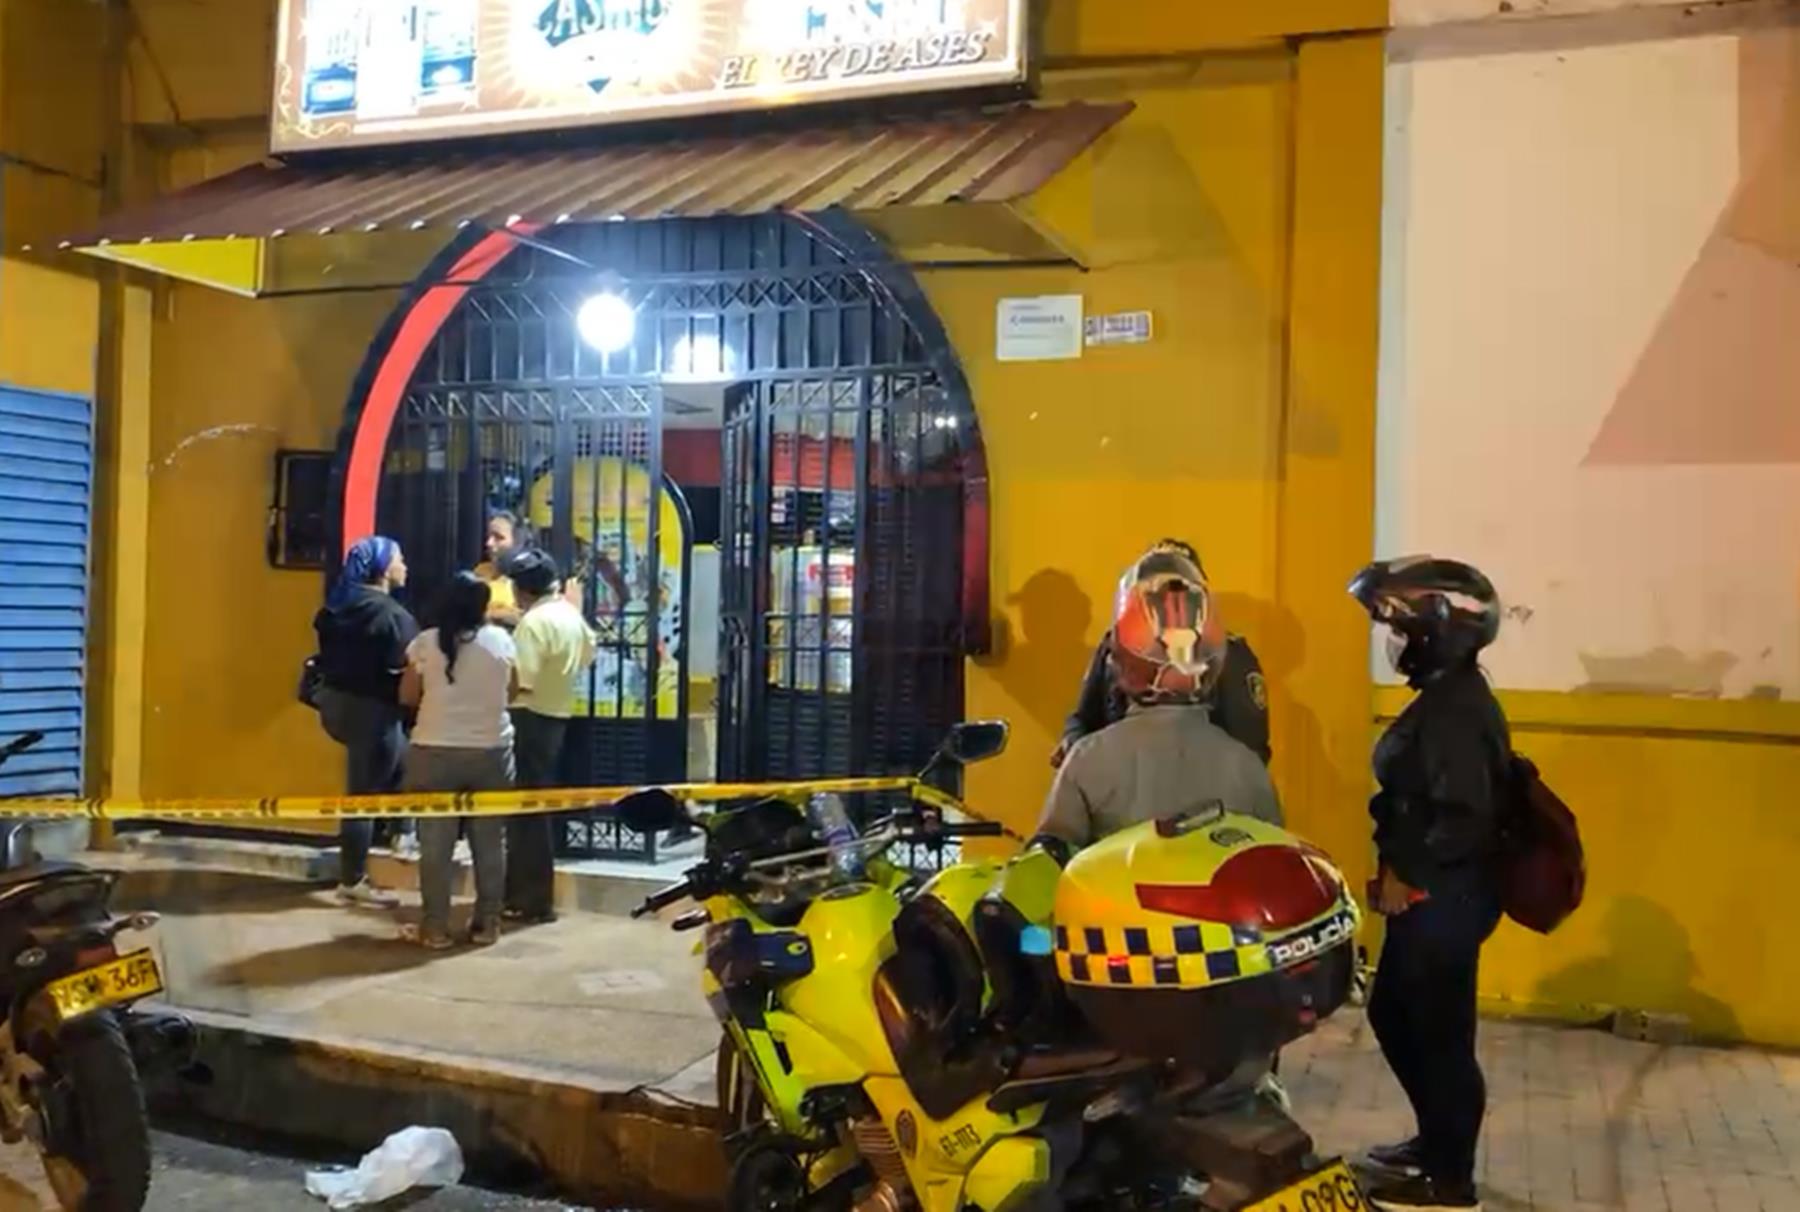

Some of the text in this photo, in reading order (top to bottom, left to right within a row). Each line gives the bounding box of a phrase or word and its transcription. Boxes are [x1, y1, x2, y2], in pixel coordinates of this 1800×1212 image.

[722, 54, 759, 89] EL
[840, 40, 897, 78] DE
[892, 29, 993, 73] ASES
[1273, 914, 1355, 964] POLICÍA
[105, 957, 150, 992] 36F
